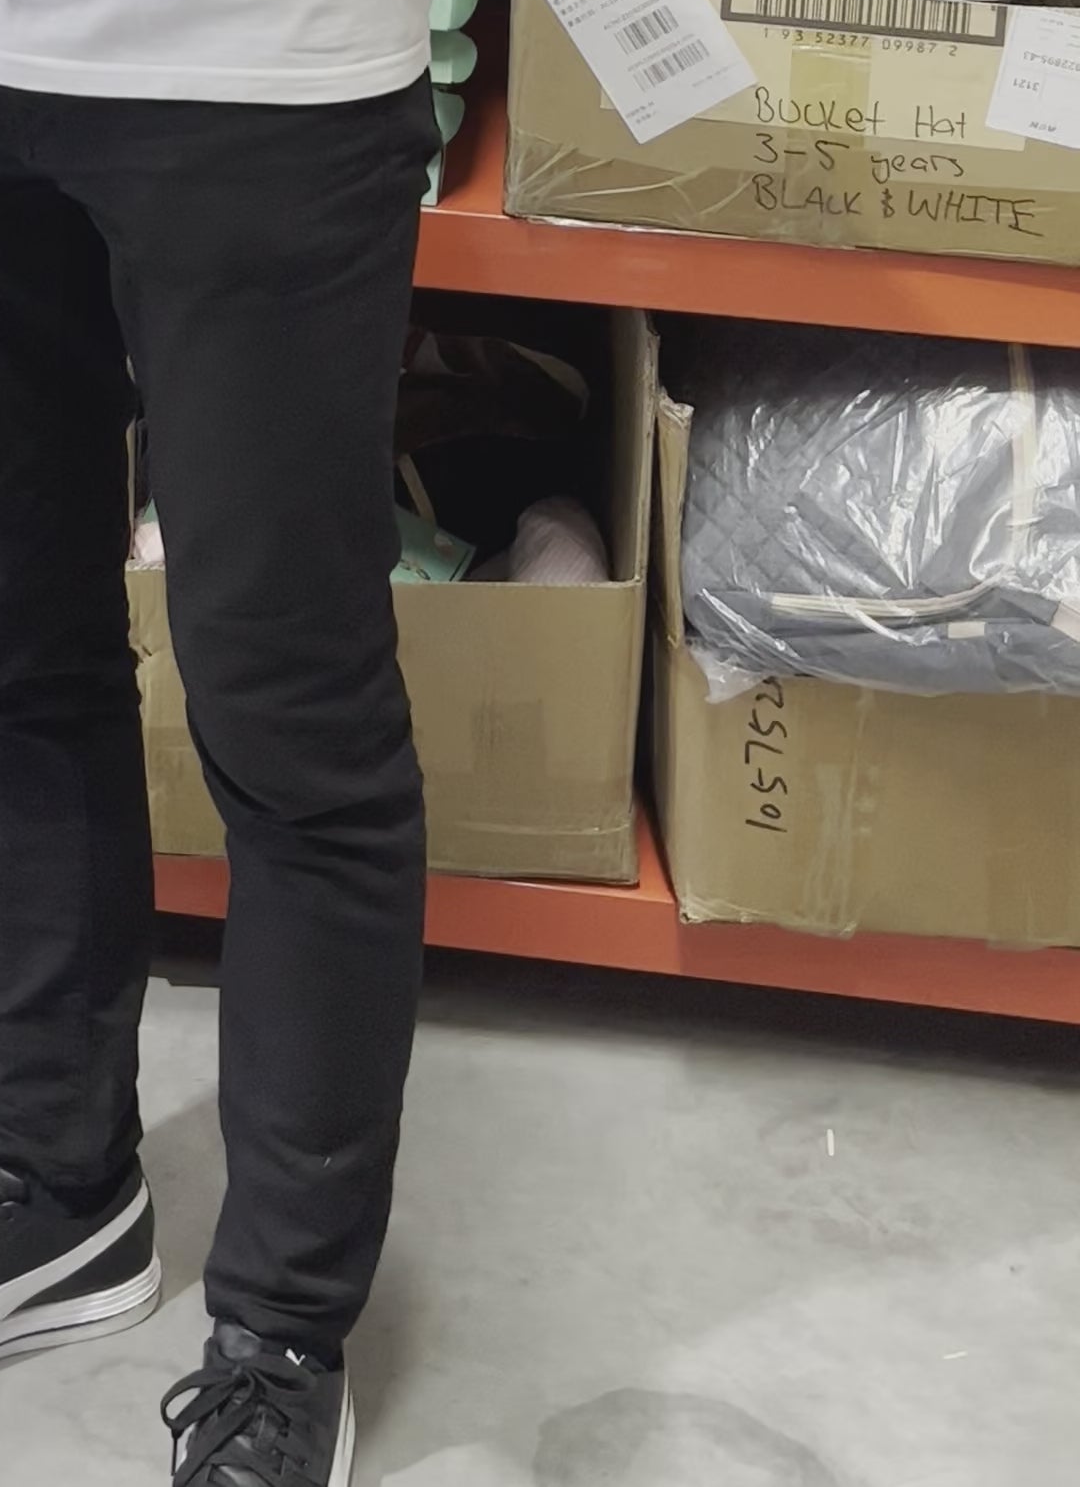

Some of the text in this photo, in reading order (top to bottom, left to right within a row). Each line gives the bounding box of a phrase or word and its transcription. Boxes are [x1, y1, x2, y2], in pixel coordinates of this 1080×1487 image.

[914, 104, 967, 139] Hat
[871, 154, 964, 184] years
[752, 173, 863, 216] BLACK
[908, 189, 1044, 237] WHITE
